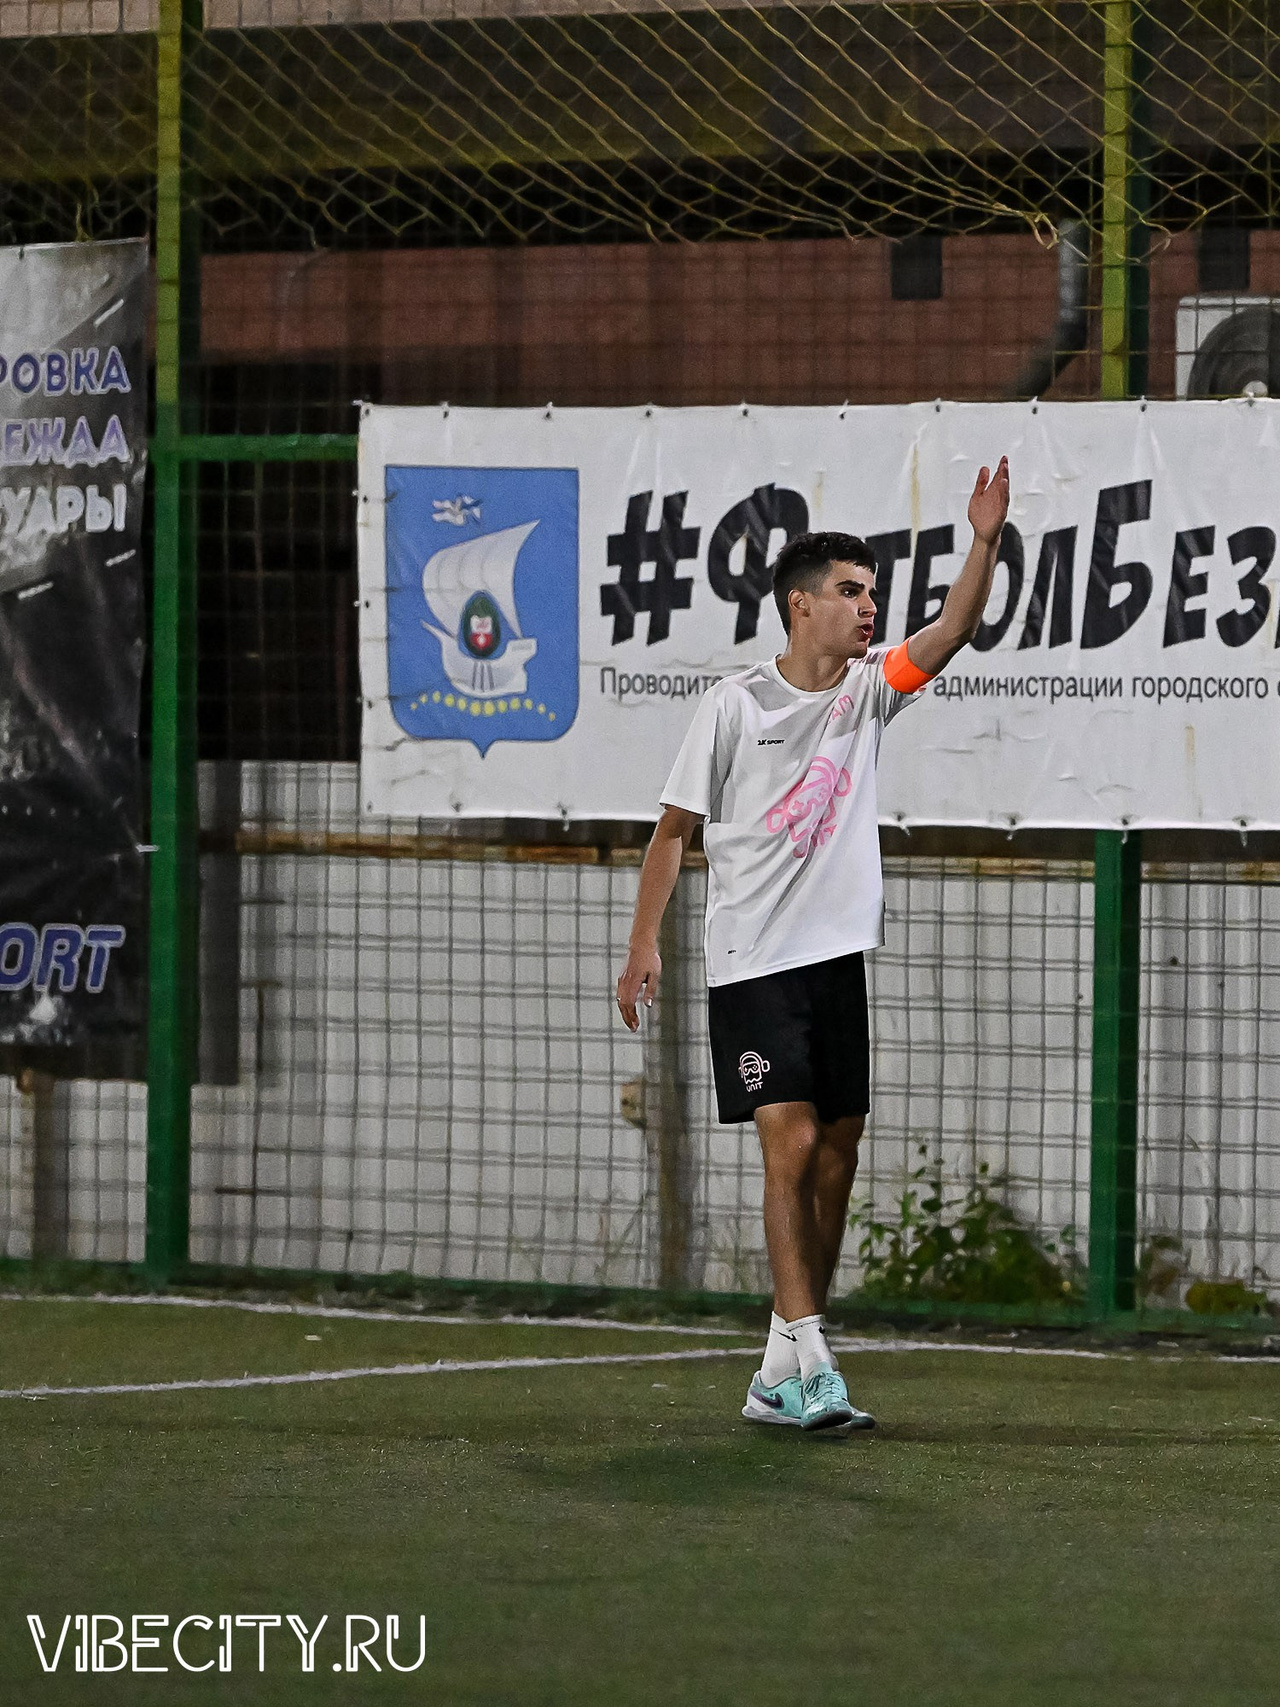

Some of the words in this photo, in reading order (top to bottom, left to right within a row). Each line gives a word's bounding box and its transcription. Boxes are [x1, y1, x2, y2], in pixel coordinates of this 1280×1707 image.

[0, 346, 131, 397] ОВКА
[933, 675, 1123, 704] администрации
[1132, 675, 1269, 704] городского
[0, 922, 126, 993] ORT
